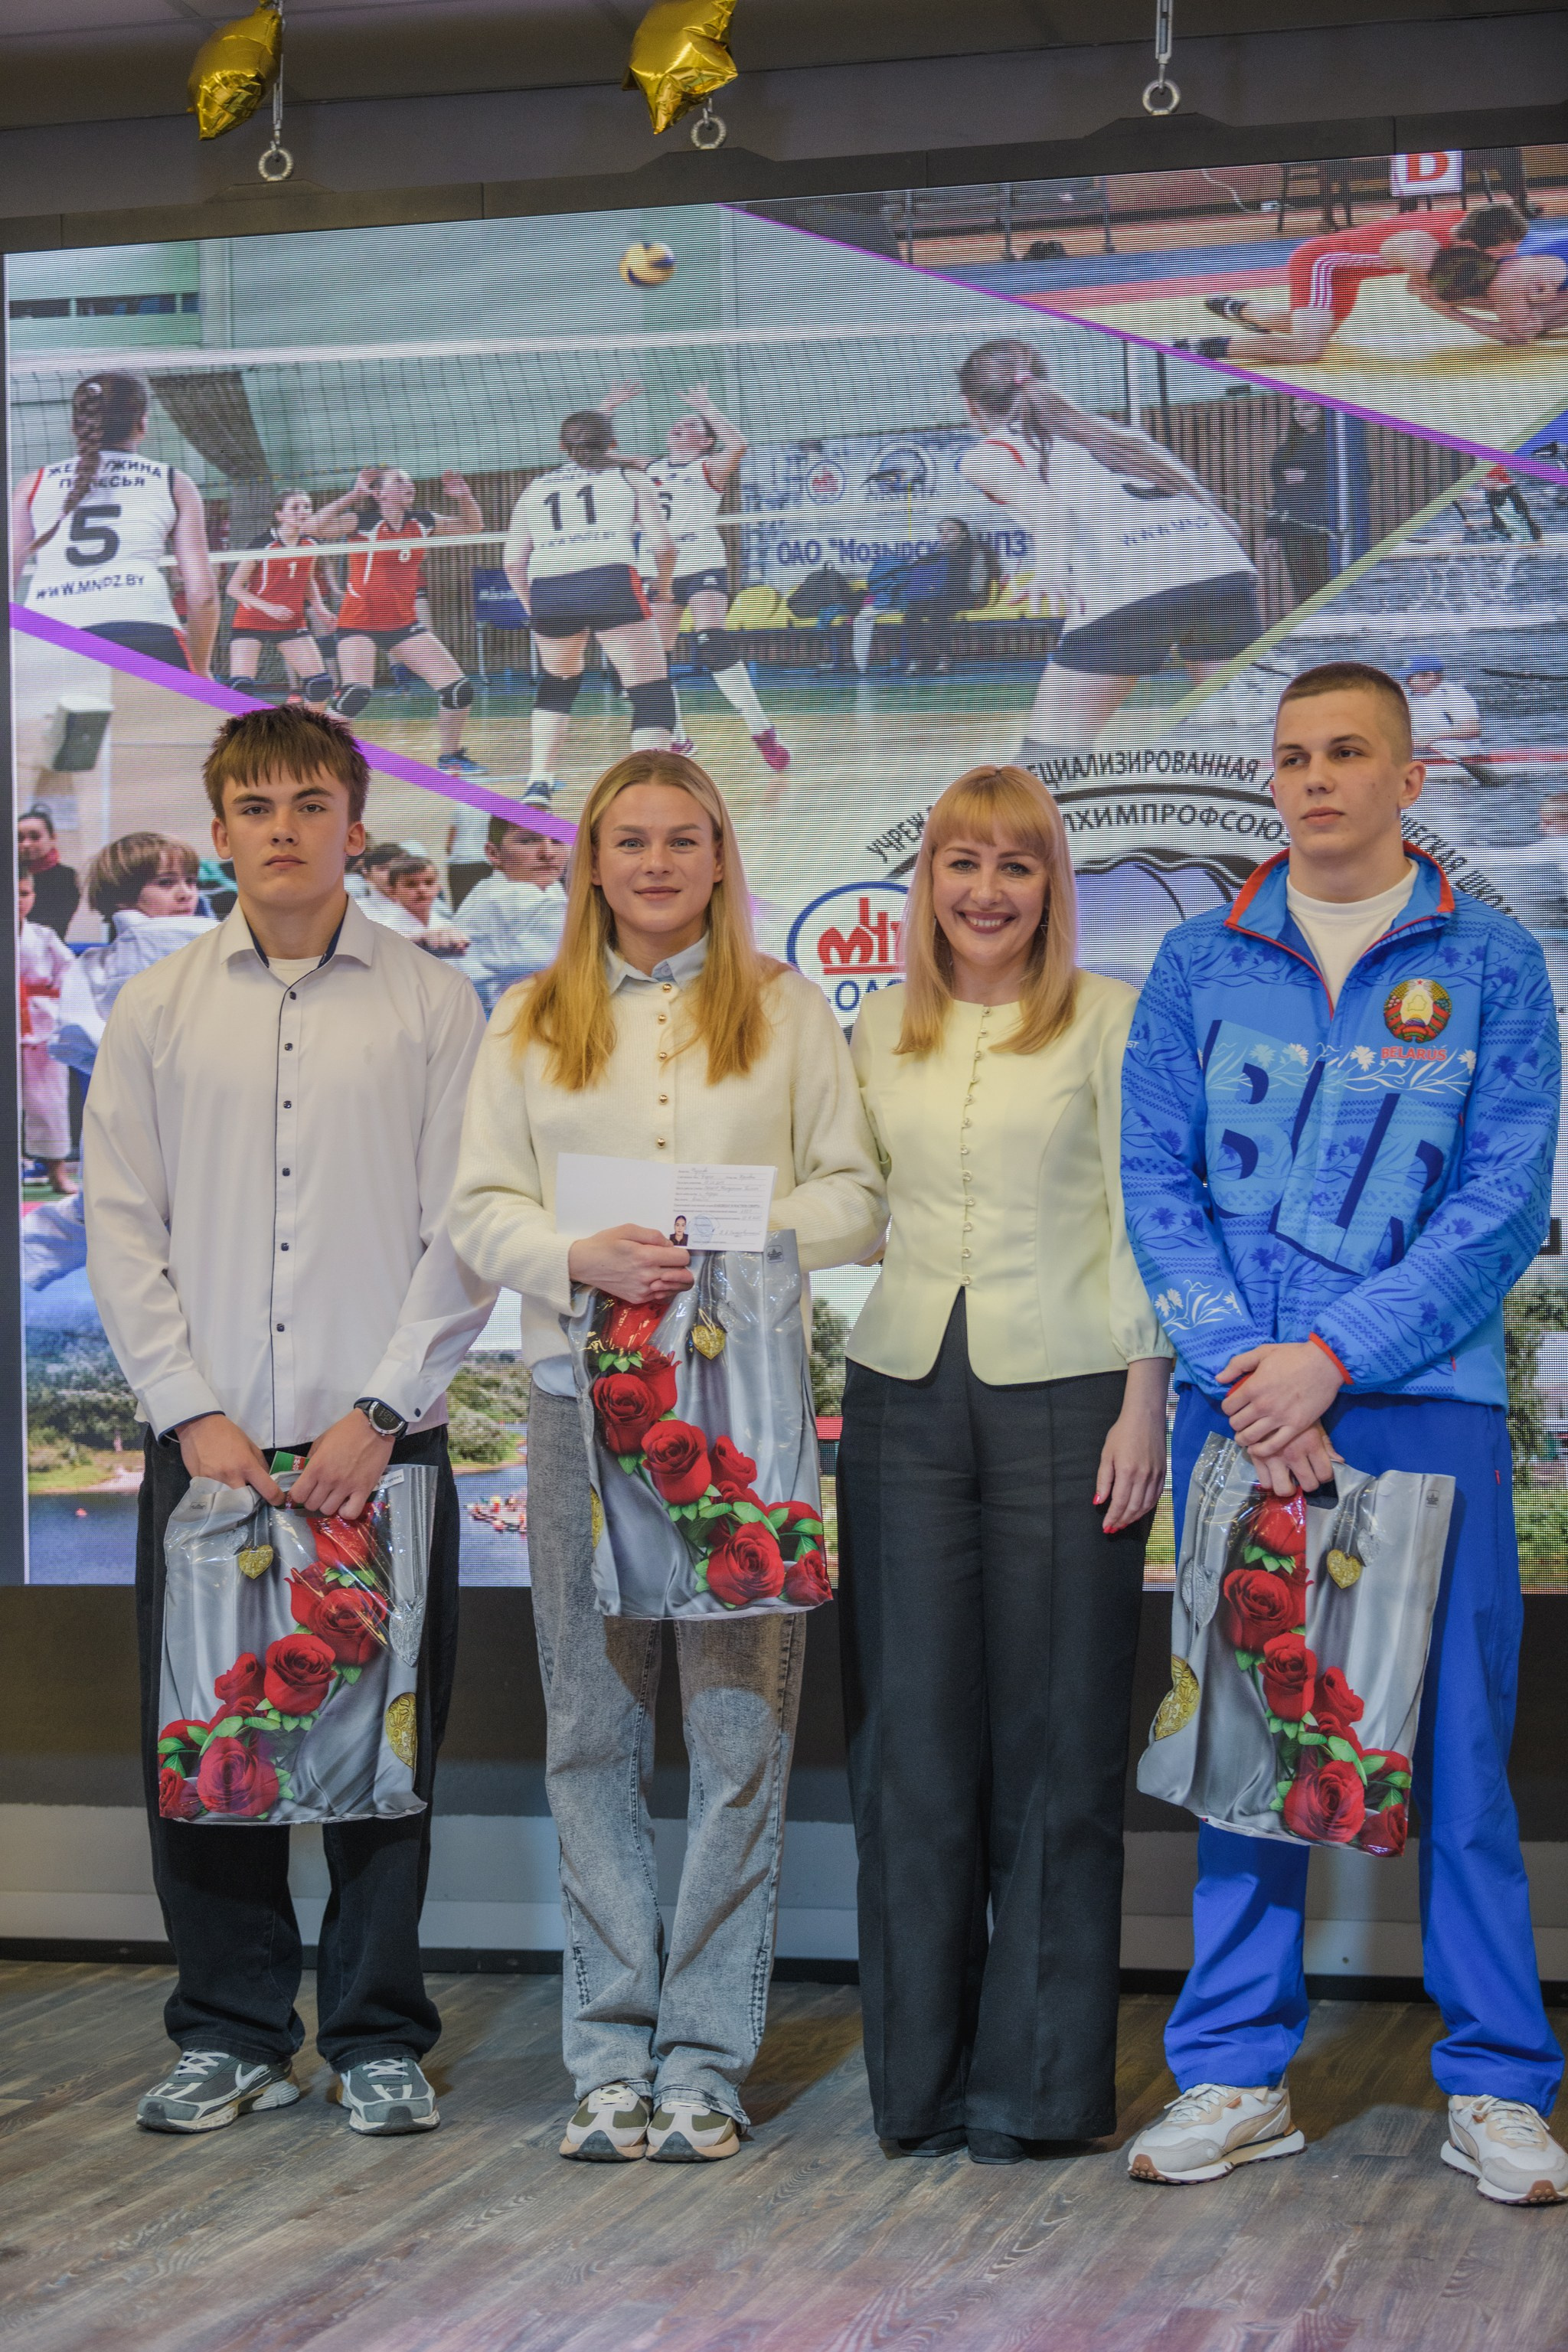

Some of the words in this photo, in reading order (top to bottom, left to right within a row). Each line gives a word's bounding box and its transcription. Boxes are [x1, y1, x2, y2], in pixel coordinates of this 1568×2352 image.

[543, 484, 597, 531] 11
[66, 504, 122, 567] 5
[777, 539, 822, 567] ОАО
[866, 805, 933, 864] УЧРЕЖ
[1027, 750, 1259, 789] ЕЦИАЛИЗИРОВАННАЯ
[1063, 804, 1292, 846] ЛХИМПРОФСОЮ
[1381, 1046, 1448, 1061] BELARUS
